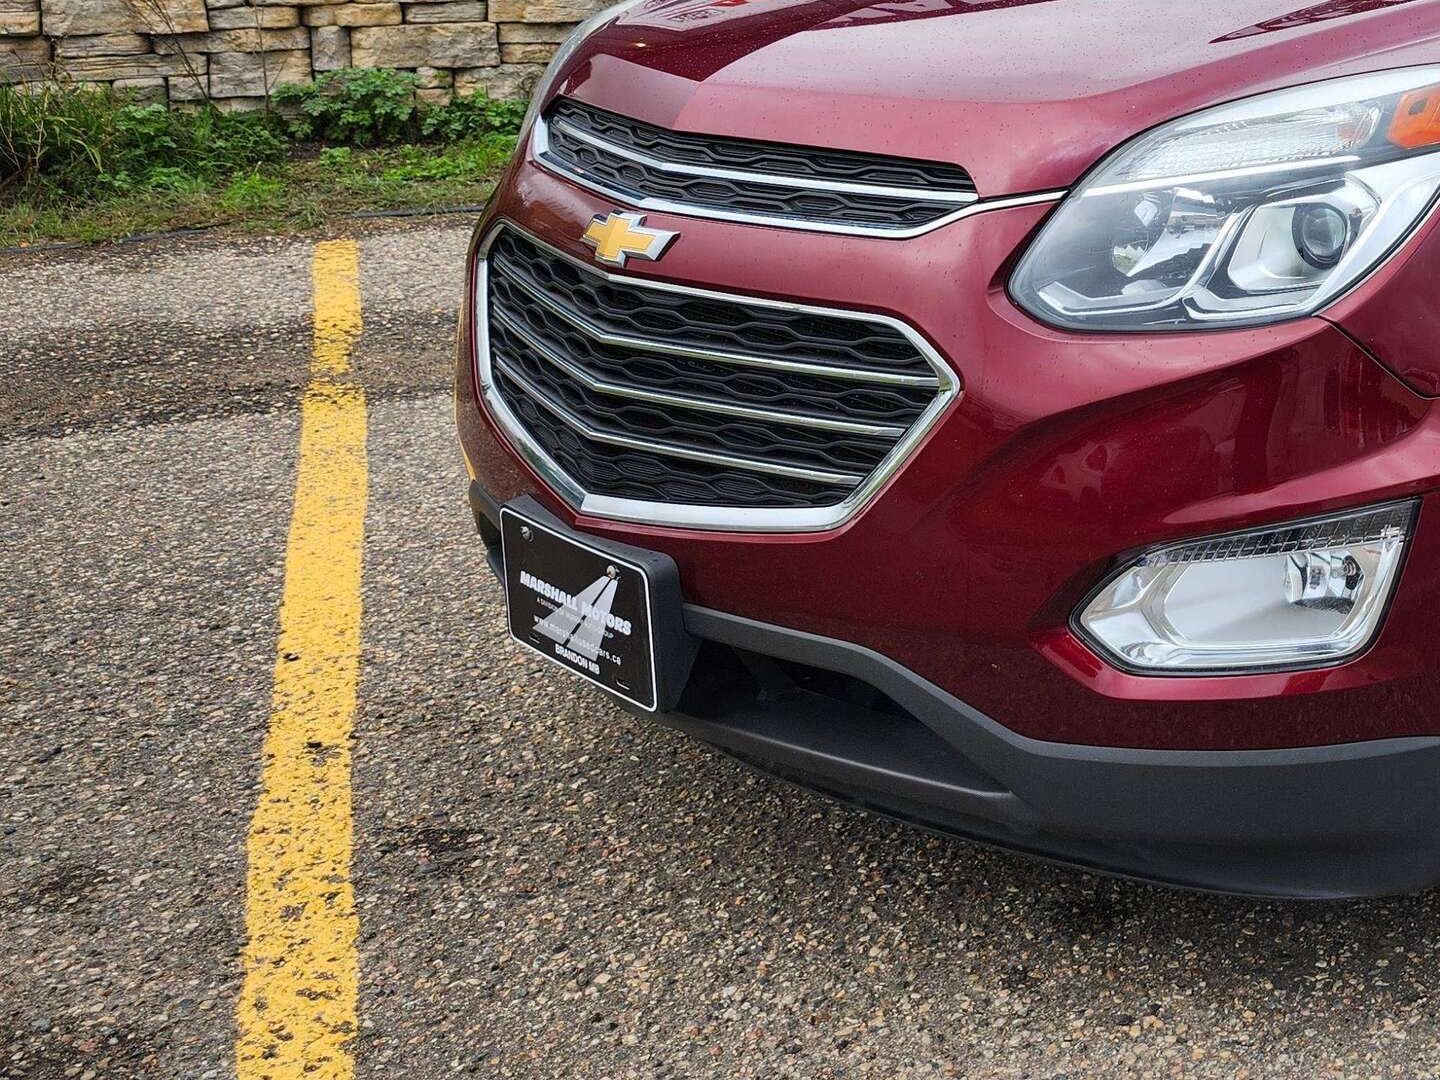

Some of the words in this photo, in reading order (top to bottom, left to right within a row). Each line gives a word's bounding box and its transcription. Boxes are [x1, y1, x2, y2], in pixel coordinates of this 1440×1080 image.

[520, 570, 578, 612] MARSHALL
[581, 601, 632, 636] MOTORS
[554, 642, 588, 670] BRANDON
[588, 661, 600, 675] MB
